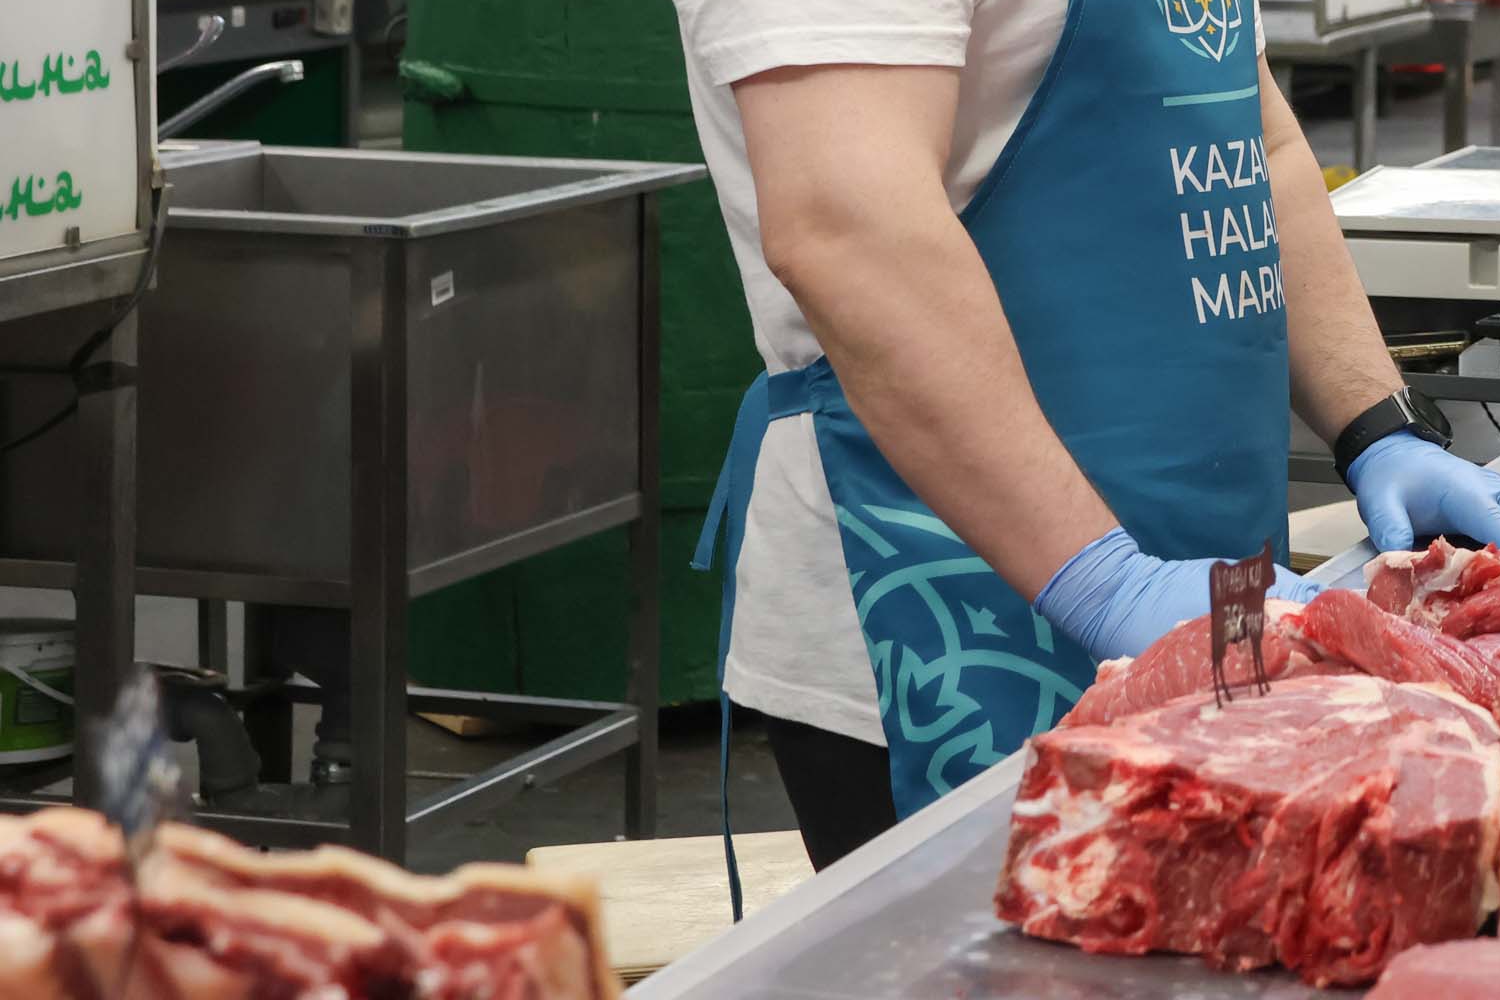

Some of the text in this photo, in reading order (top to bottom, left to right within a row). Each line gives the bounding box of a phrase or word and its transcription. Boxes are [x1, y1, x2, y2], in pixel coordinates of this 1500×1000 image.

[1169, 135, 1269, 195] KAZA
[1180, 198, 1279, 260] HALA
[1191, 260, 1286, 324] MARK
